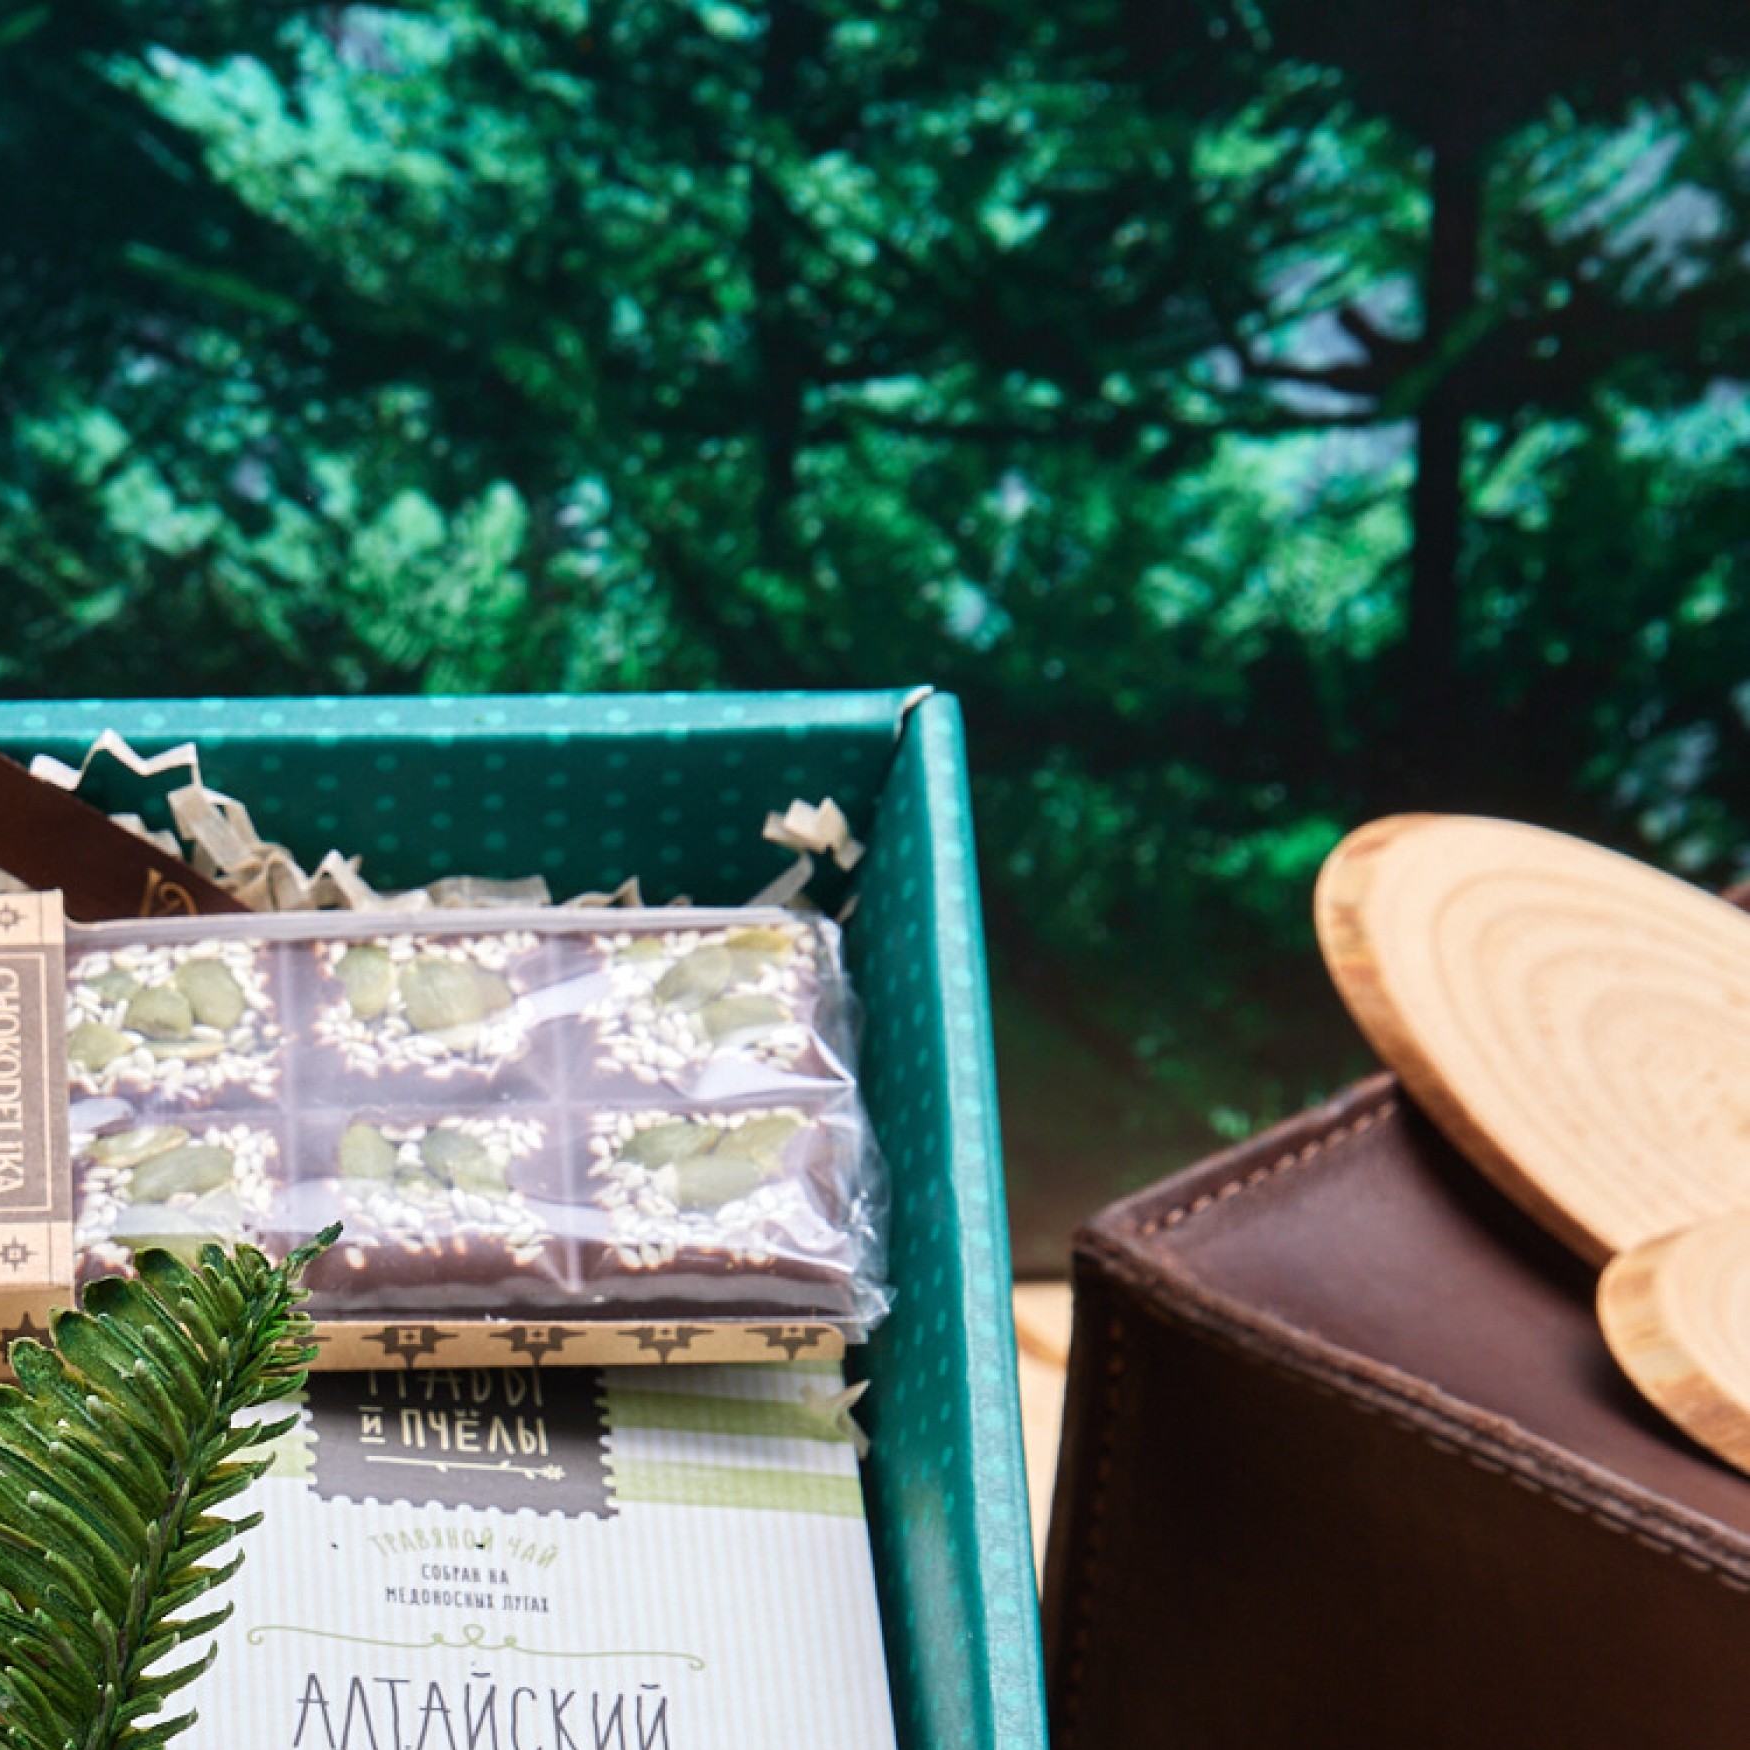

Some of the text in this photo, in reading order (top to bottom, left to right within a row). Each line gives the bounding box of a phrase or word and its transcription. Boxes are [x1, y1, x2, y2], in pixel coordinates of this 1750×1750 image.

[400, 1408, 550, 1457] ПЧЁЛЫ
[368, 1526, 560, 1568] ТРАВЯНОЙ ЧАЙ
[421, 1563, 509, 1585] СОБРАН НА
[385, 1586, 549, 1613] МЕДОНОСНЫХ ЛУГАХ
